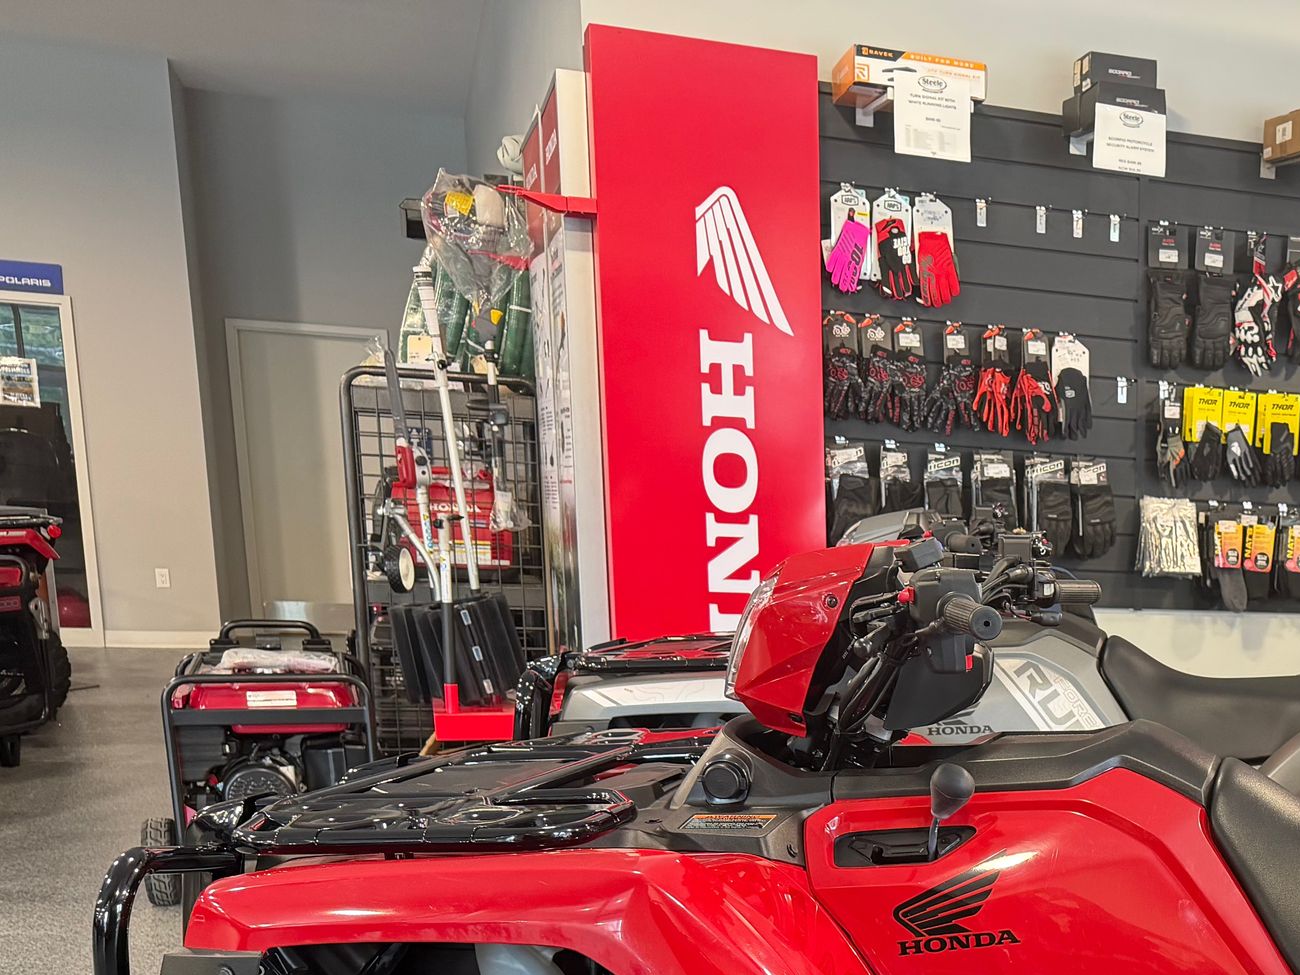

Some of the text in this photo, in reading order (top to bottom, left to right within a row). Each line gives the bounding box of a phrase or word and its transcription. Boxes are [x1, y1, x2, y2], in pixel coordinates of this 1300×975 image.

[910, 54, 931, 62] BUILT
[1198, 398, 1218, 406] THOR
[1229, 402, 1250, 410] THOR
[701, 329, 760, 633] HON
[928, 725, 993, 736] HONDA
[898, 929, 1021, 957] HONDA
